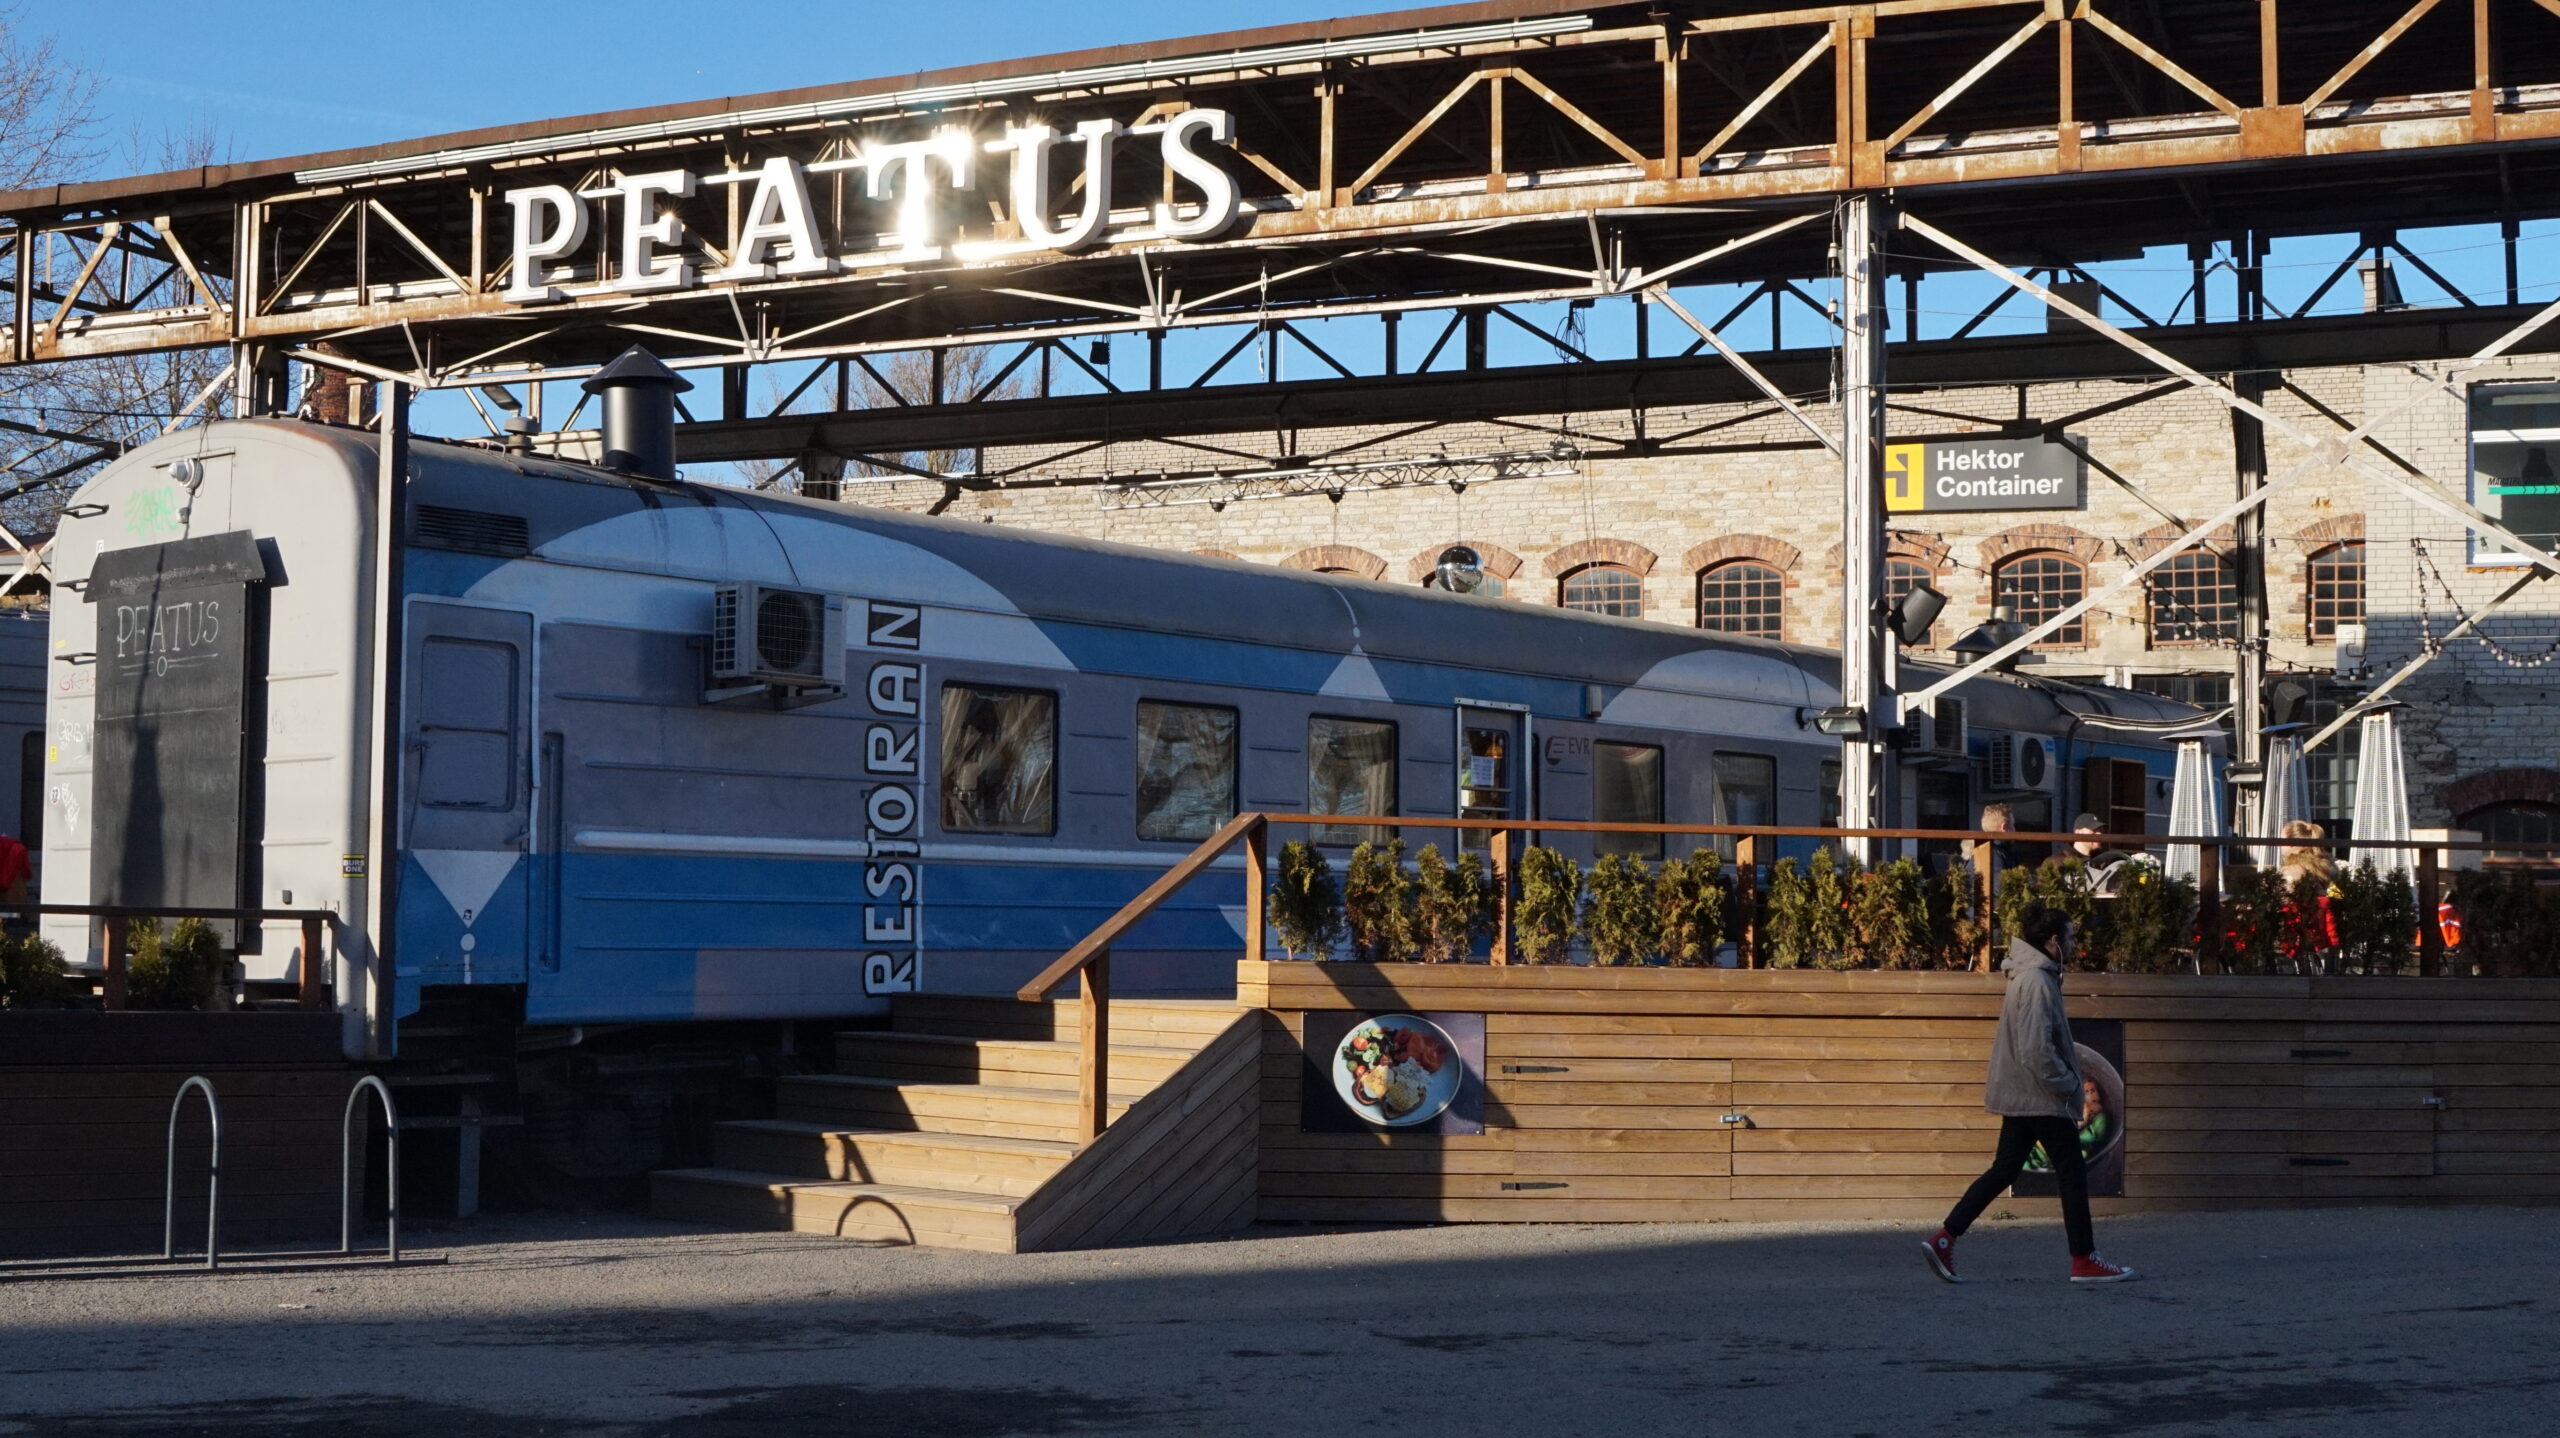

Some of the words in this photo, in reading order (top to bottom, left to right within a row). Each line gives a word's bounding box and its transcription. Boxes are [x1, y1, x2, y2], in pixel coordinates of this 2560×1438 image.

[503, 107, 1242, 305] PEATUS
[1936, 449, 2025, 471] Hektor
[1936, 475, 2064, 498] Container
[117, 601, 220, 658] PEATUS
[1568, 737, 1591, 756] EVR
[864, 602, 921, 999] RESTORAN
